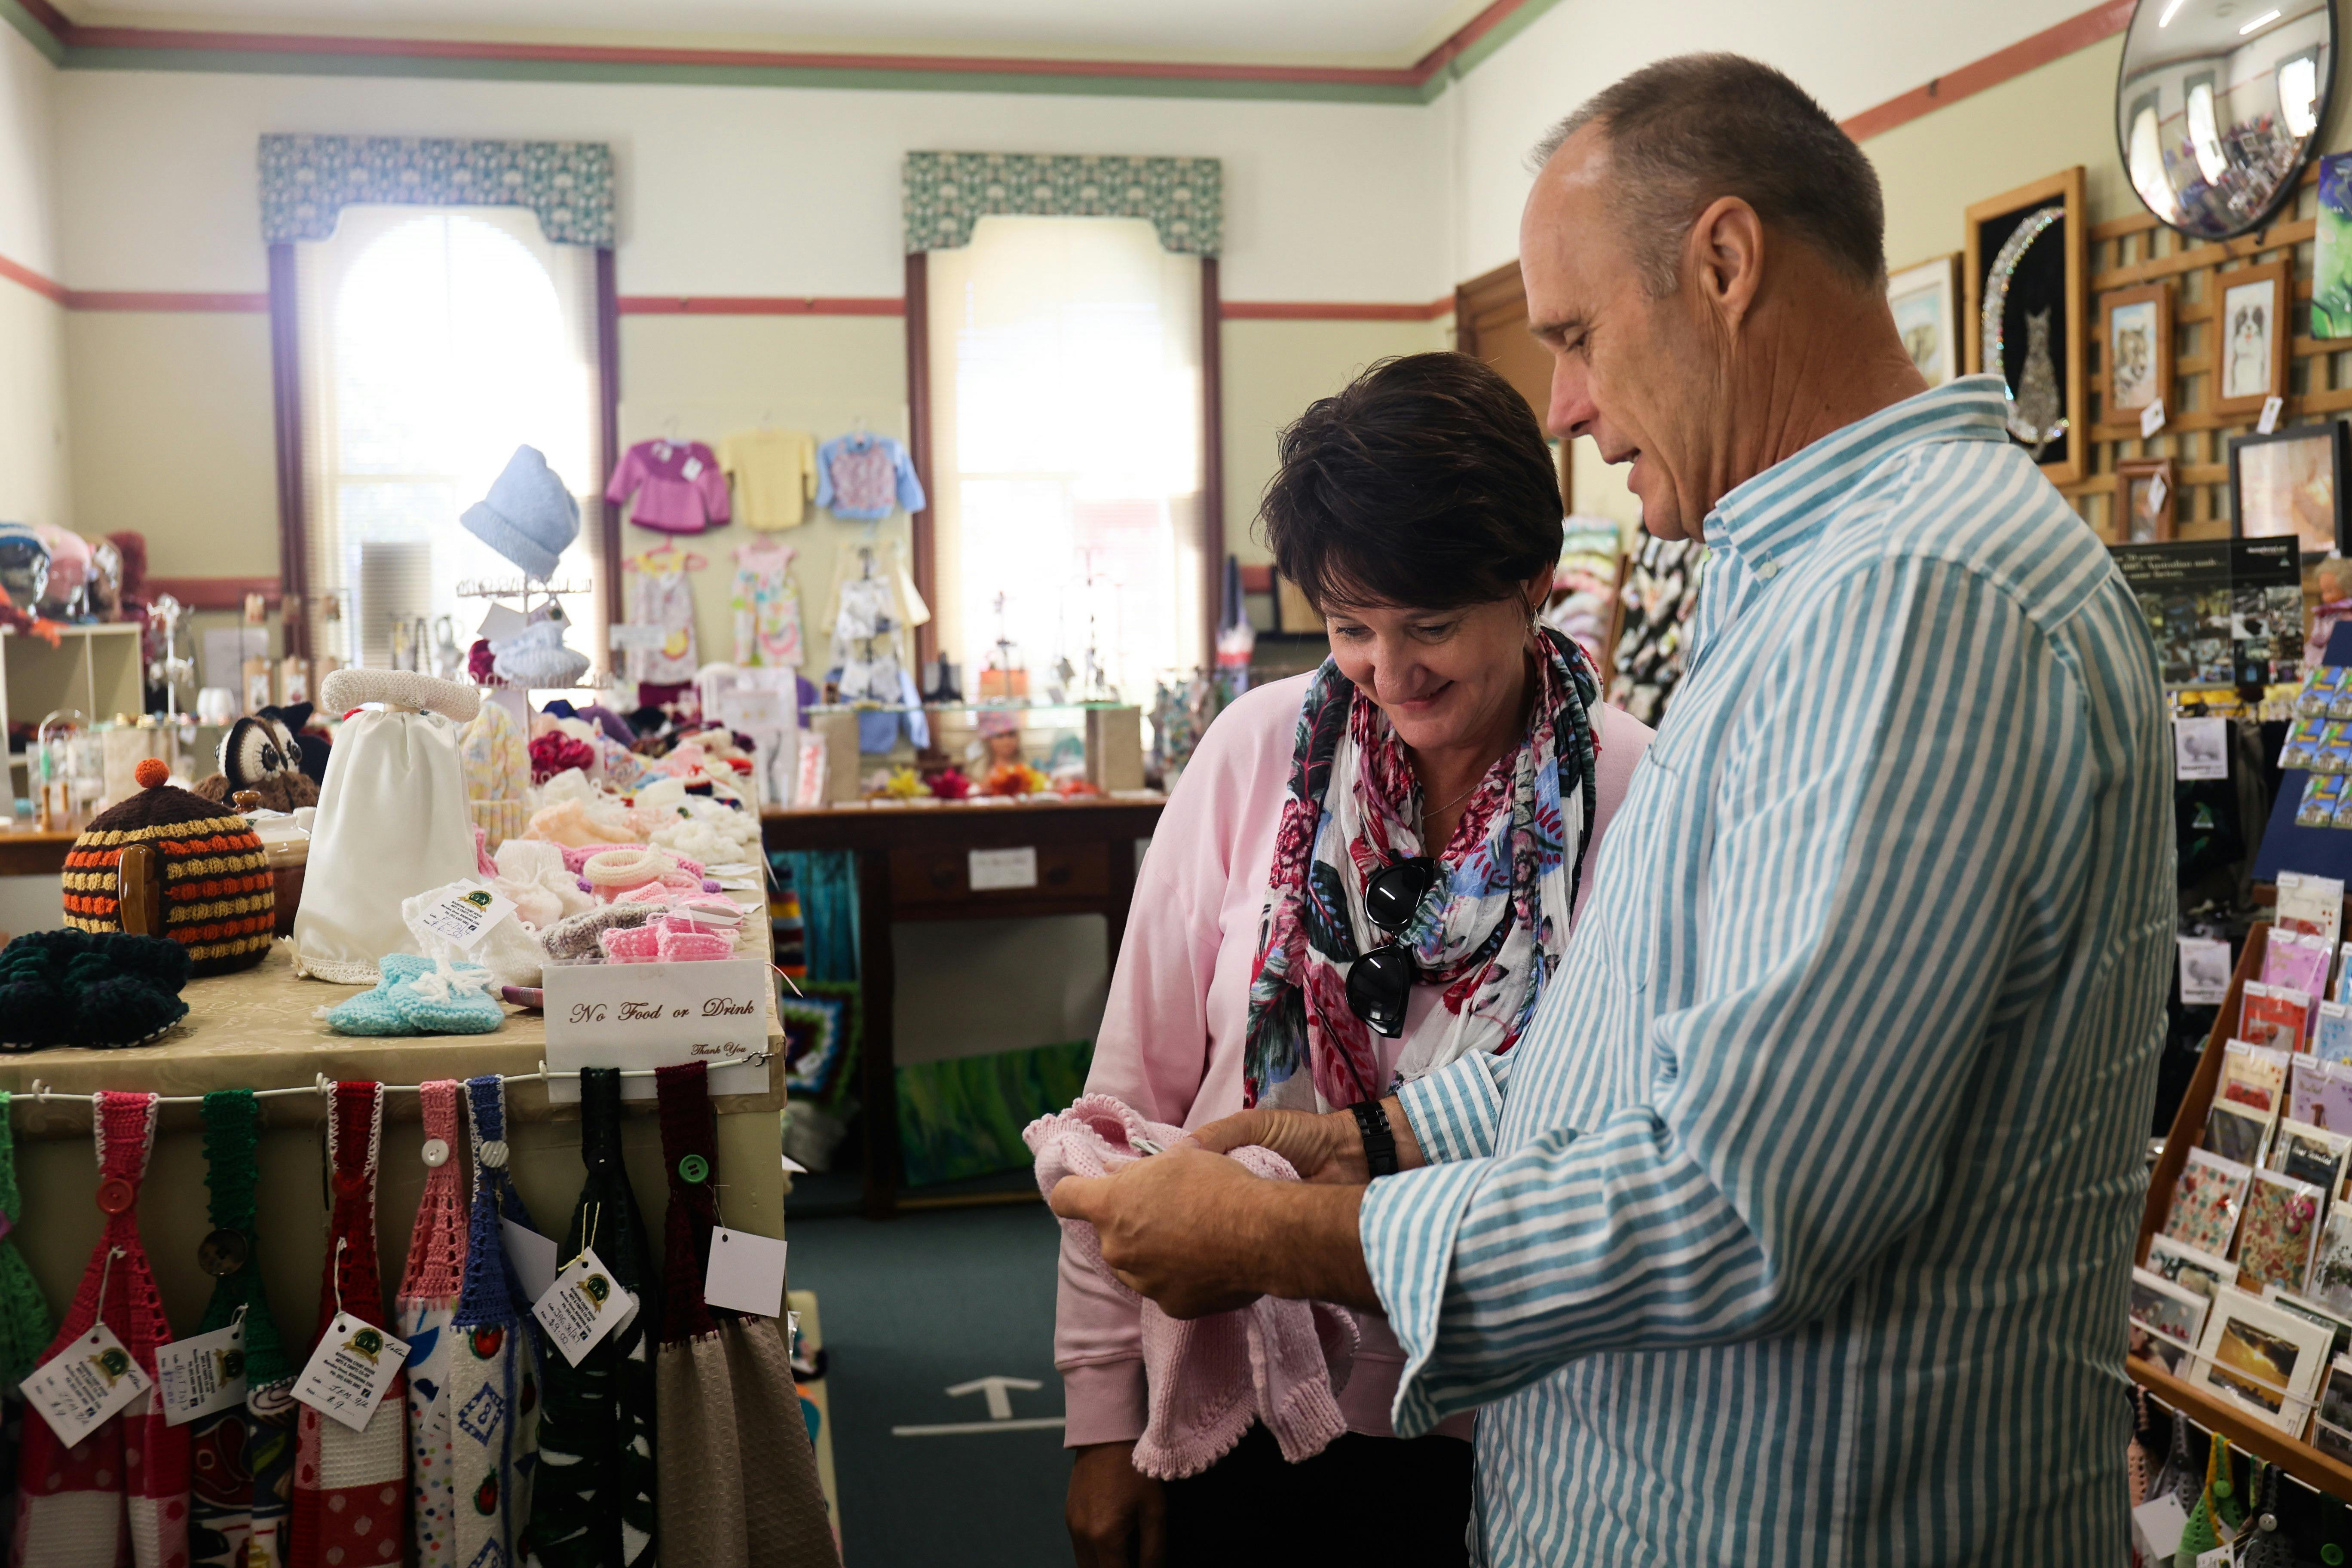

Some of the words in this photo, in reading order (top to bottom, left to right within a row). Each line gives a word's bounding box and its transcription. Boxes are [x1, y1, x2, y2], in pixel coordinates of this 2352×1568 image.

[570, 1004, 607, 1023] No
[618, 1002, 663, 1021] Food
[673, 1008, 689, 1018] or
[701, 998, 754, 1017] Drink
[691, 1044, 721, 1056] Thank
[723, 1042, 747, 1057] You
